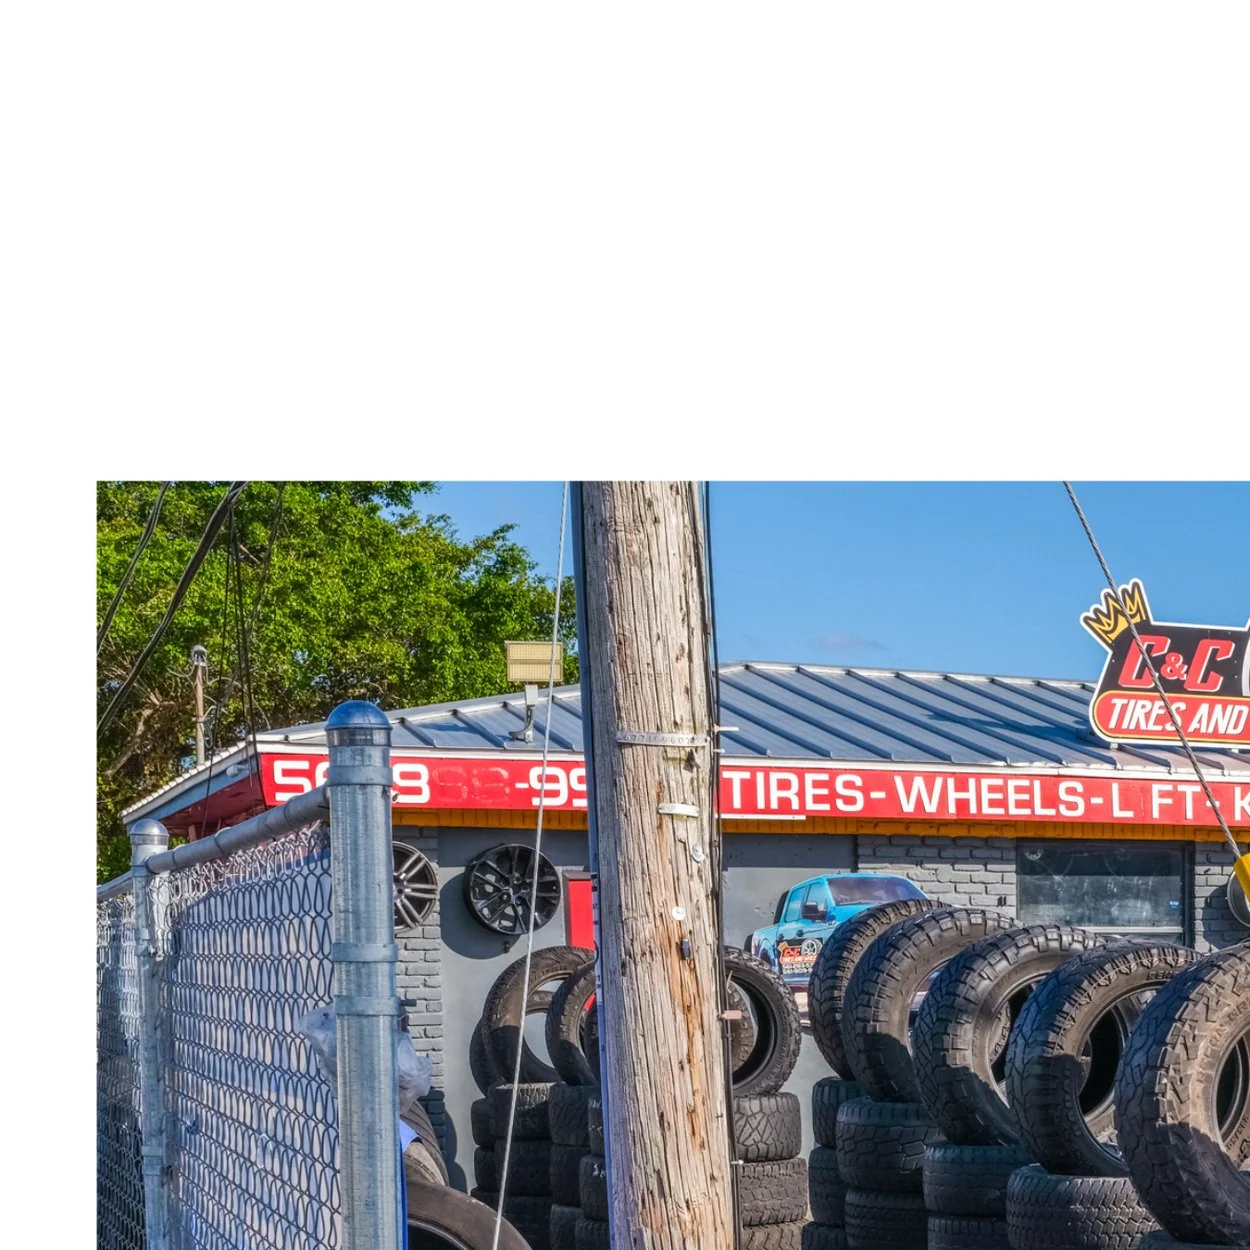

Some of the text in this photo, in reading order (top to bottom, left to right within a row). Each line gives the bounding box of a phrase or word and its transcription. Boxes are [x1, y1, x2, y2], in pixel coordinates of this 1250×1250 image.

[1118, 634, 1236, 693] C&C
[1110, 697, 1186, 732] TIRES
[1187, 702, 1250, 736] AND
